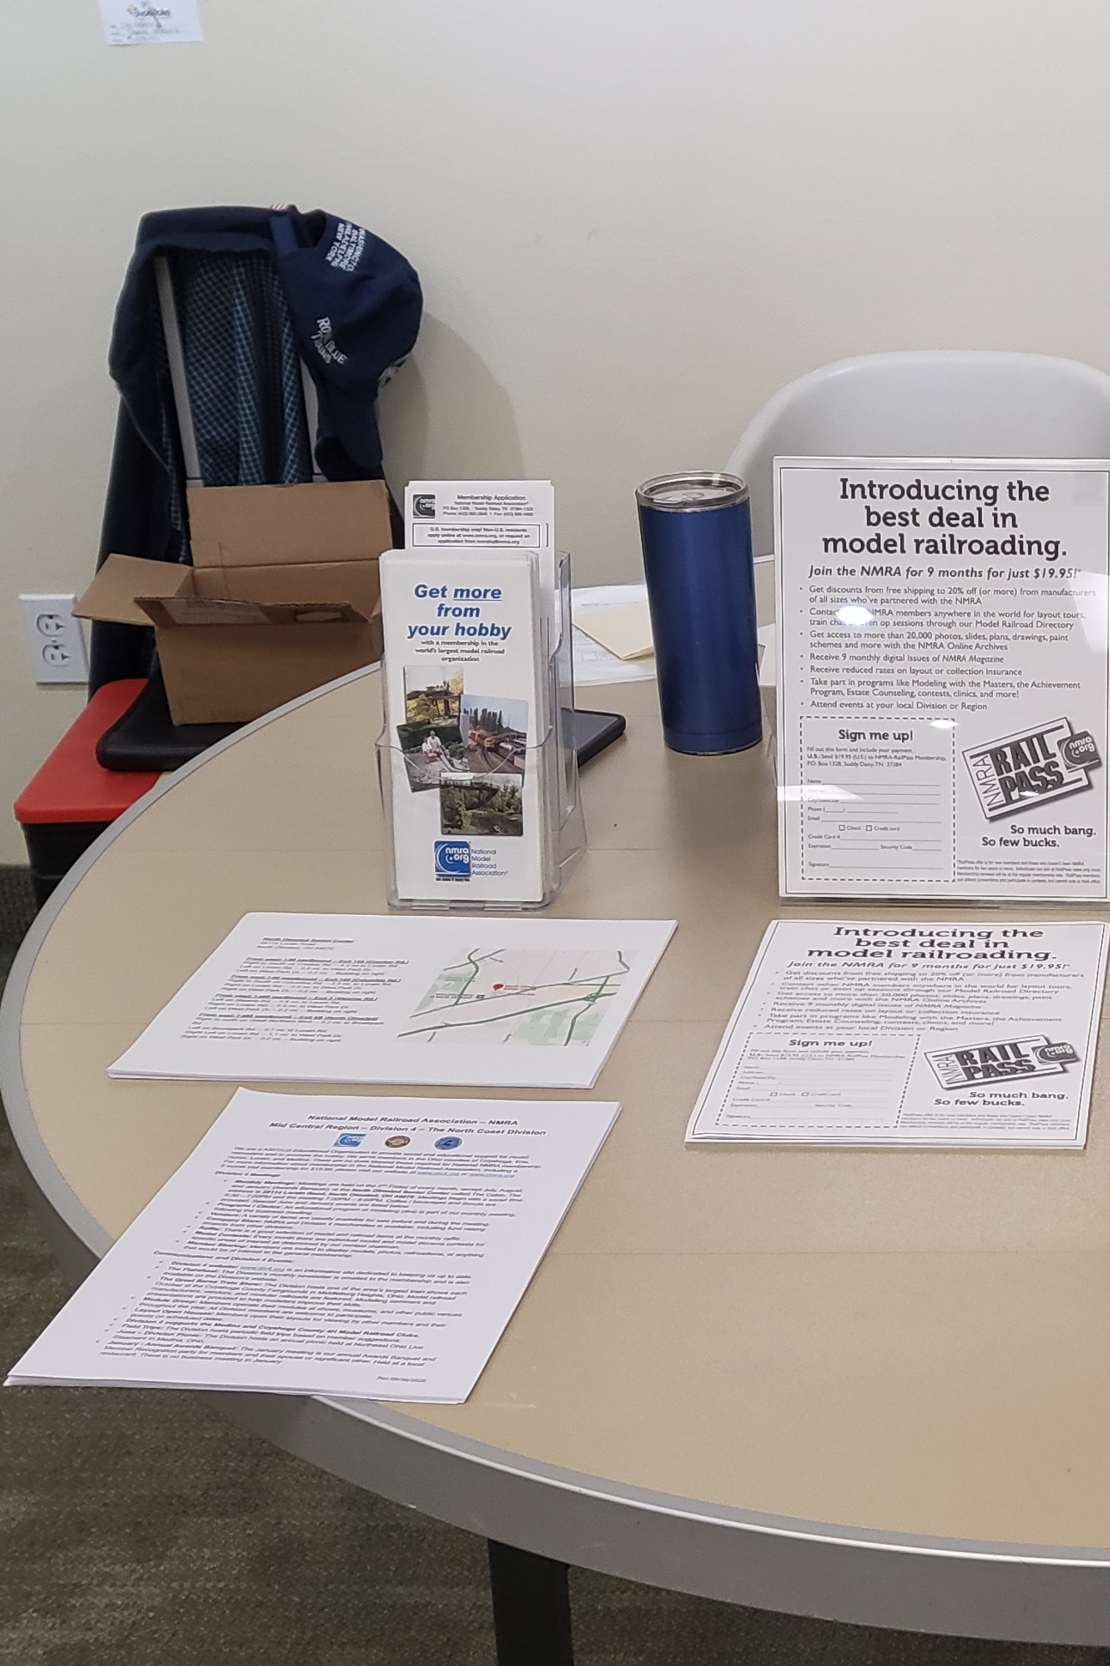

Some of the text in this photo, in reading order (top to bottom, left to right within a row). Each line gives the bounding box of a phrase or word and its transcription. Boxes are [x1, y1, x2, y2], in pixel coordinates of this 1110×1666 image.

[325, 242, 341, 262] YORK
[325, 340, 347, 364] BLUE
[840, 478, 1049, 505] Introducing the
[865, 506, 1018, 528] best deal in
[822, 533, 1066, 561] model railroading.
[809, 565, 832, 578] Join
[837, 566, 856, 576] the
[861, 566, 901, 576] NMRA
[906, 566, 923, 579] for
[928, 567, 934, 577] 9
[938, 567, 983, 577] months
[987, 567, 1004, 579] for
[1007, 568, 1029, 579] just
[415, 584, 502, 599] Get more
[437, 603, 480, 617] from
[407, 622, 511, 640] your hobby
[810, 700, 837, 708] Attend
[897, 701, 914, 709] local
[916, 701, 947, 709] Division
[961, 702, 987, 712] Region
[839, 729, 912, 743] Sign me up!
[1069, 736, 1092, 749] nmra
[990, 734, 1056, 776] RAIL
[973, 754, 1004, 806] NMRA
[998, 760, 1064, 802] PASS
[1011, 825, 1096, 837] So much bang.
[982, 837, 1059, 847] So few bucks.
[834, 927, 1044, 940] Introducing the
[856, 938, 1009, 948] best deal in
[808, 949, 1056, 961] model railroading.
[955, 1043, 1030, 1066] RAIL
[962, 1059, 1036, 1080] PASS
